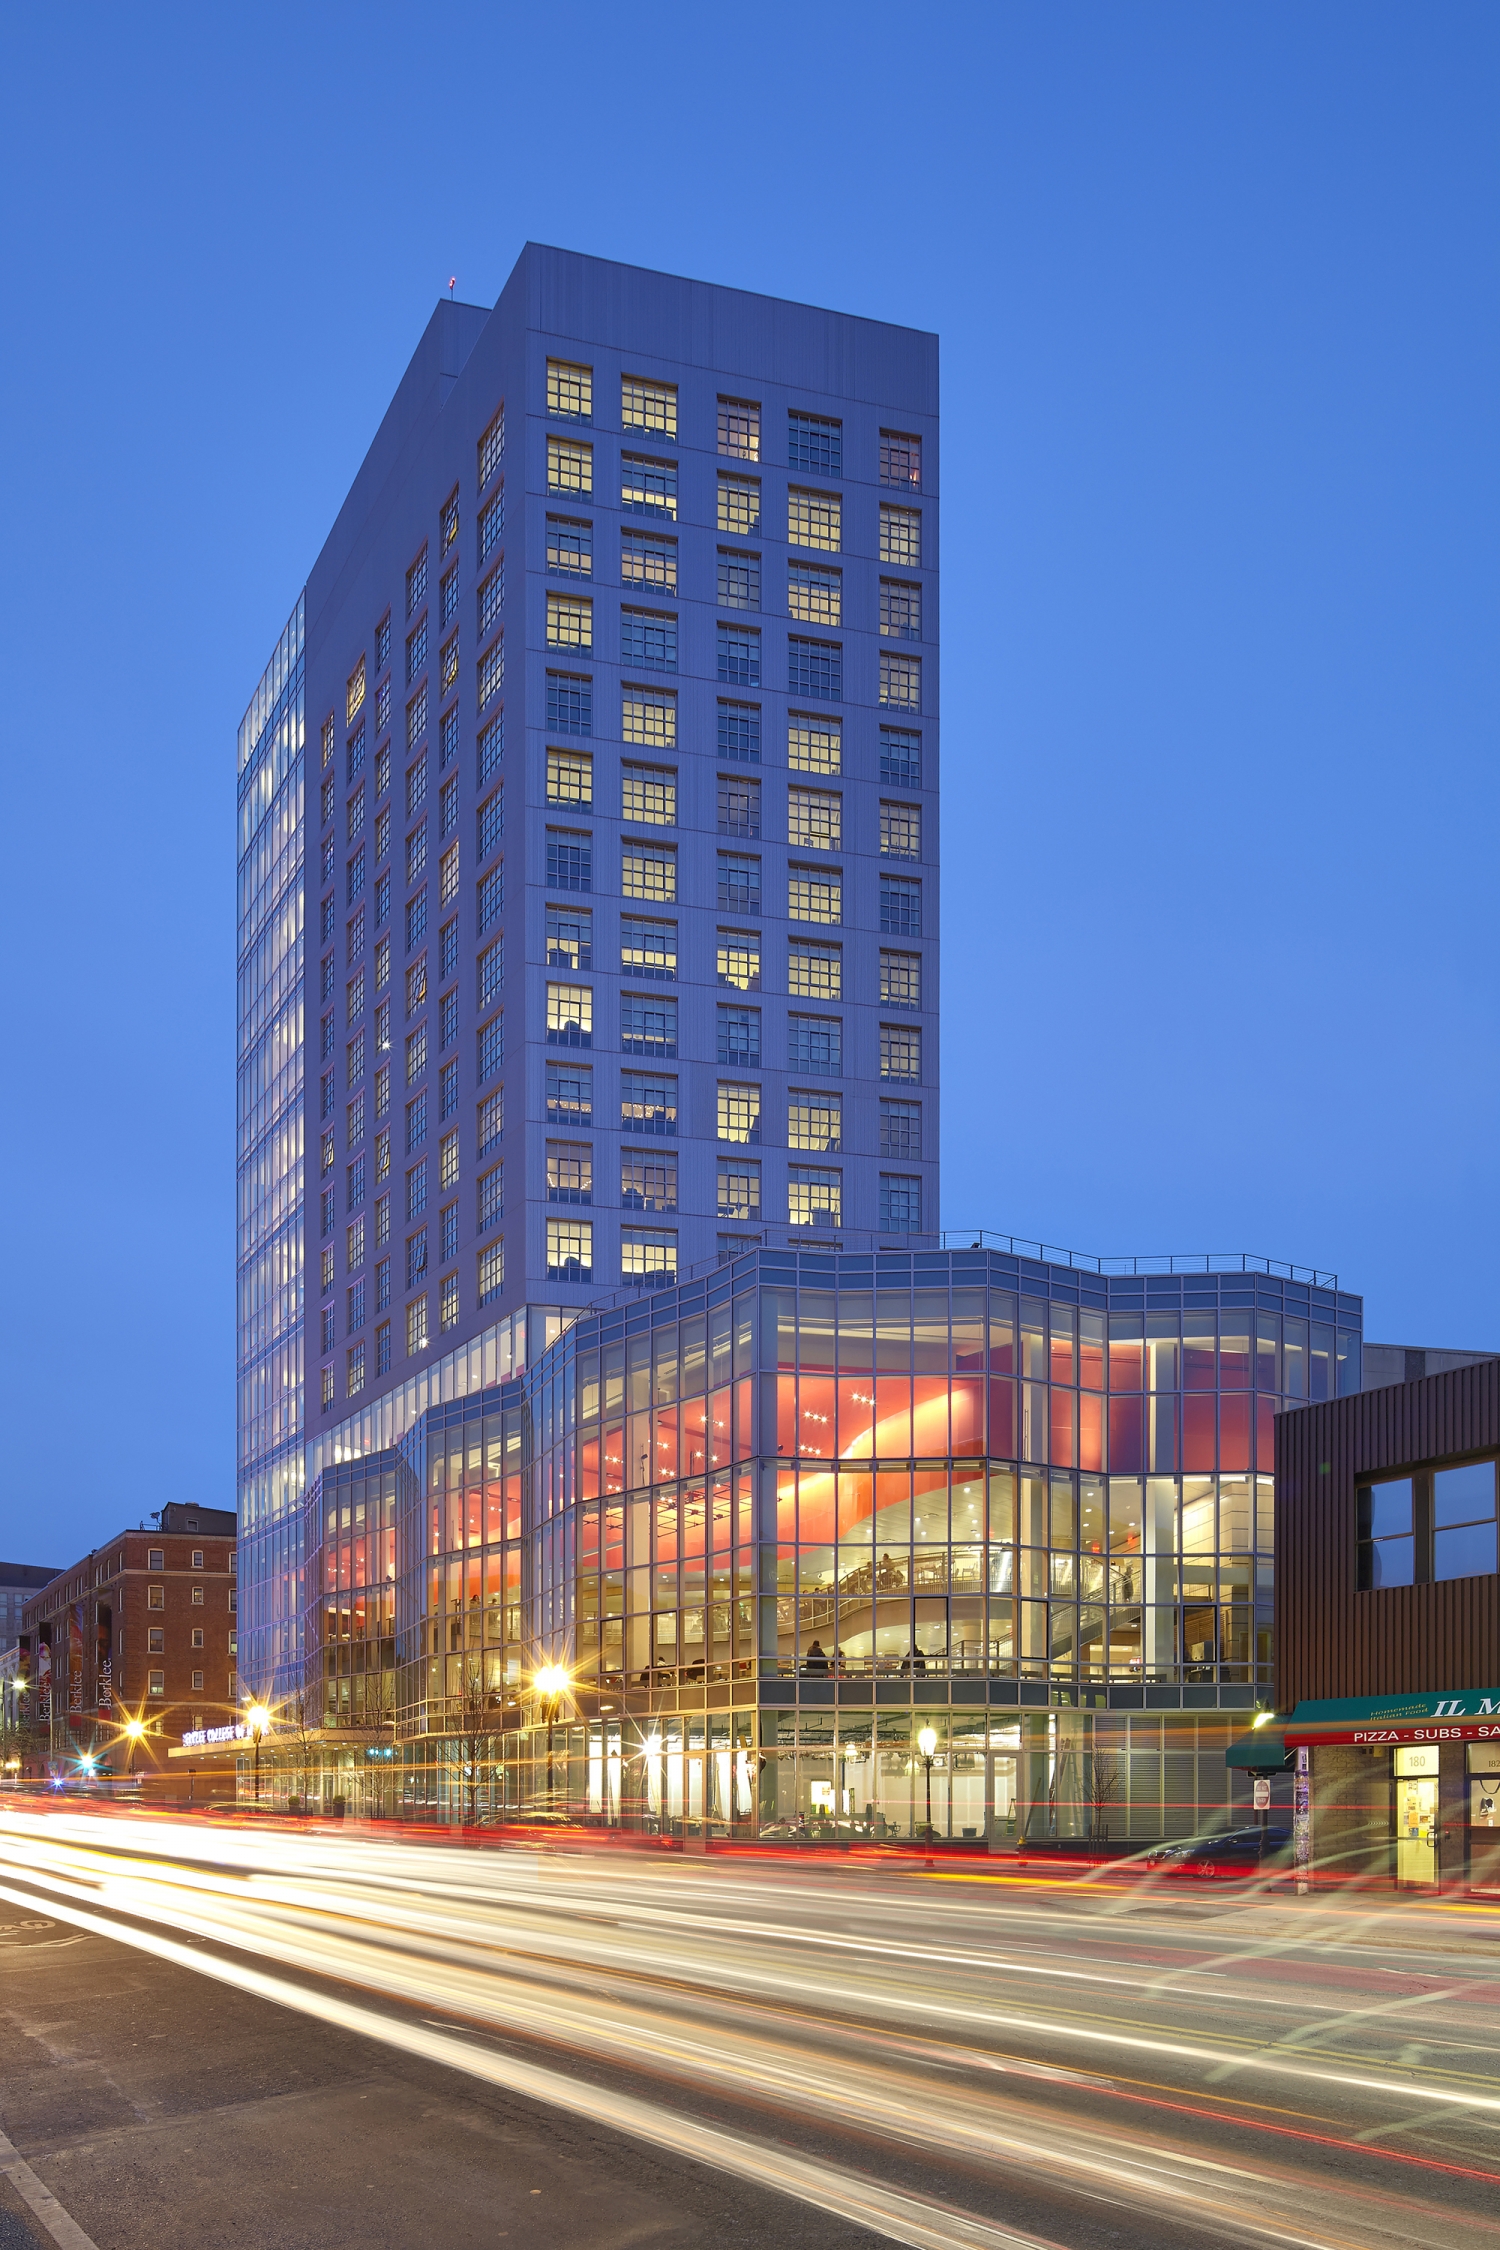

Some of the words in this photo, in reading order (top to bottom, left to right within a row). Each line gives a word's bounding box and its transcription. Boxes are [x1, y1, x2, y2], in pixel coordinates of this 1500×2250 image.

[70, 1670, 82, 1714] Berklee
[99, 1660, 112, 1707] Berklee
[20, 1692, 30, 1728] Berklee
[40, 1682, 51, 1721] Berklee
[1370, 1703, 1427, 1716] Homemade
[1430, 1700, 1466, 1717] IL
[1369, 1712, 1403, 1721] Italian
[1405, 1707, 1429, 1715] Food
[1354, 1731, 1399, 1742] PIZZA
[1414, 1727, 1461, 1740] SUBS
[1478, 1726, 1500, 1737] SA
[1409, 1755, 1426, 1767] 180
